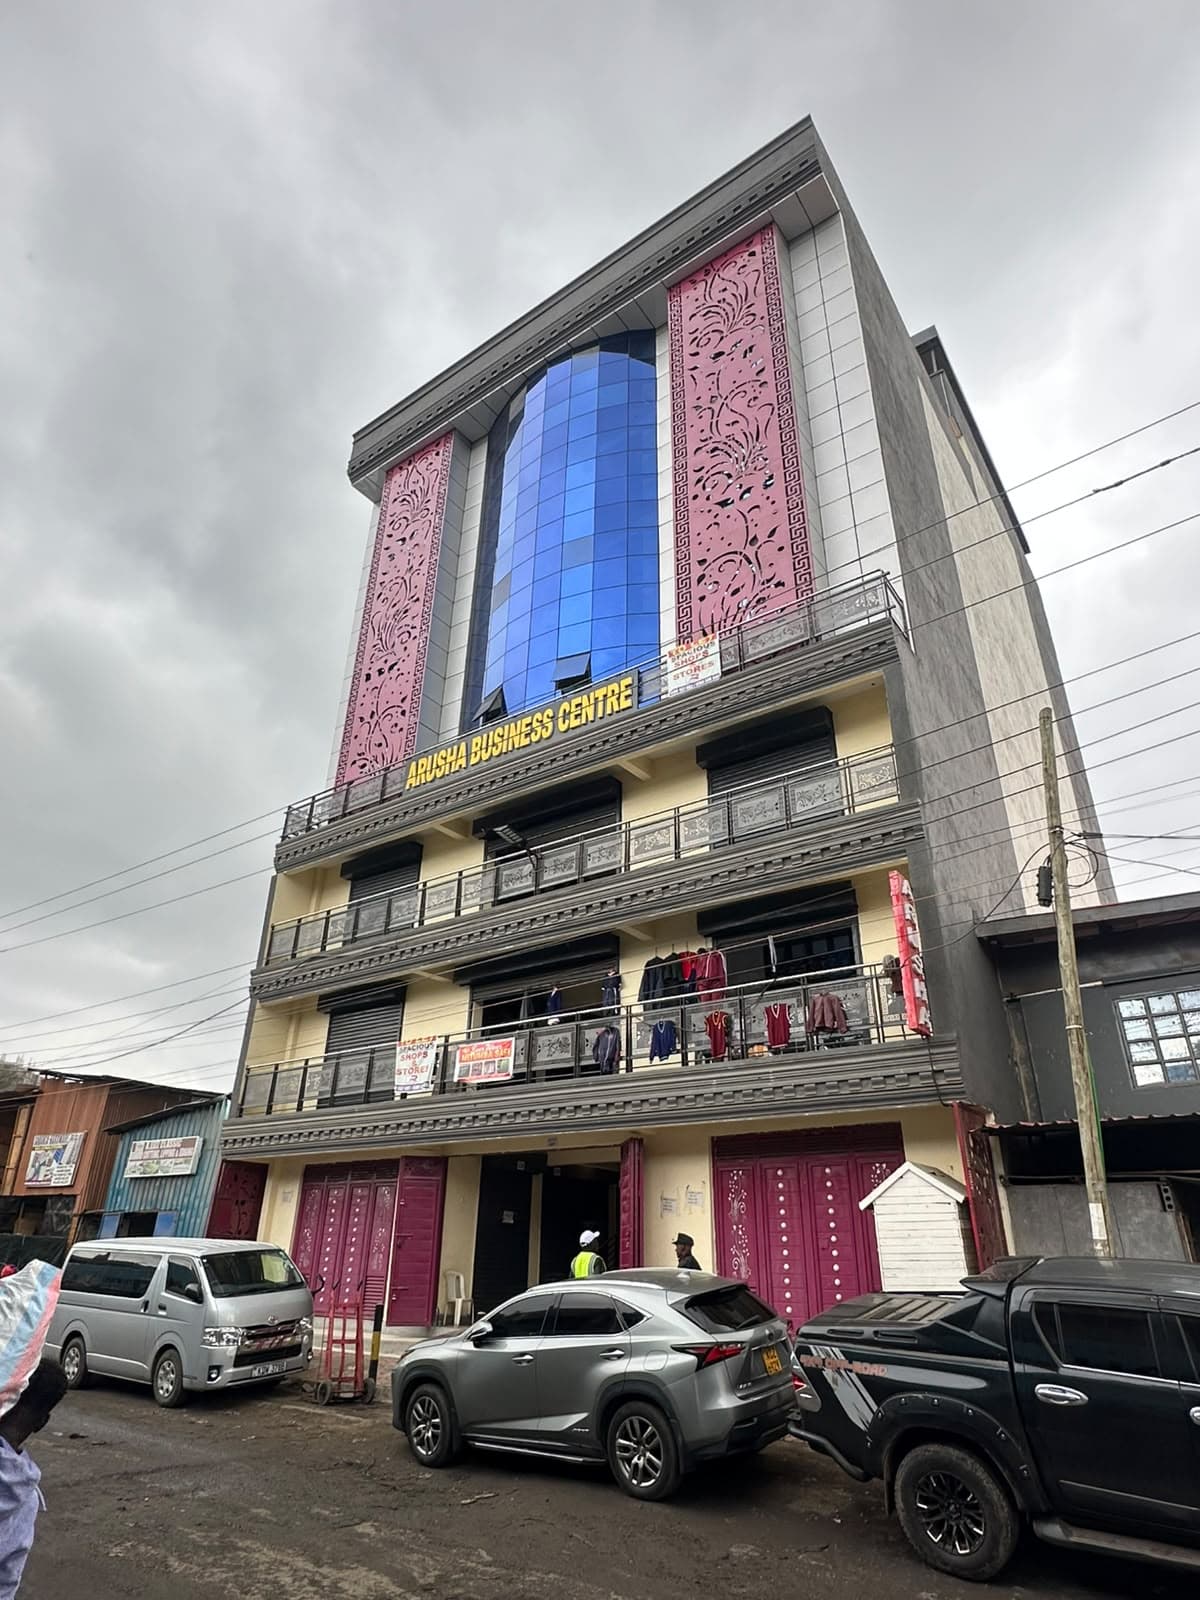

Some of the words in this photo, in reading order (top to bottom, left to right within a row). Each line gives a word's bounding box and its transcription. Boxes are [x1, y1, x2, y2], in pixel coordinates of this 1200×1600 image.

[671, 641, 716, 663] SPACIOUS
[673, 649, 709, 668] SHOPS
[672, 661, 714, 681] STORES
[406, 742, 467, 790] ARUSHA
[470, 710, 554, 766] BUSINESS
[558, 677, 633, 733] CENTRE
[400, 1050, 429, 1061] SHOPS
